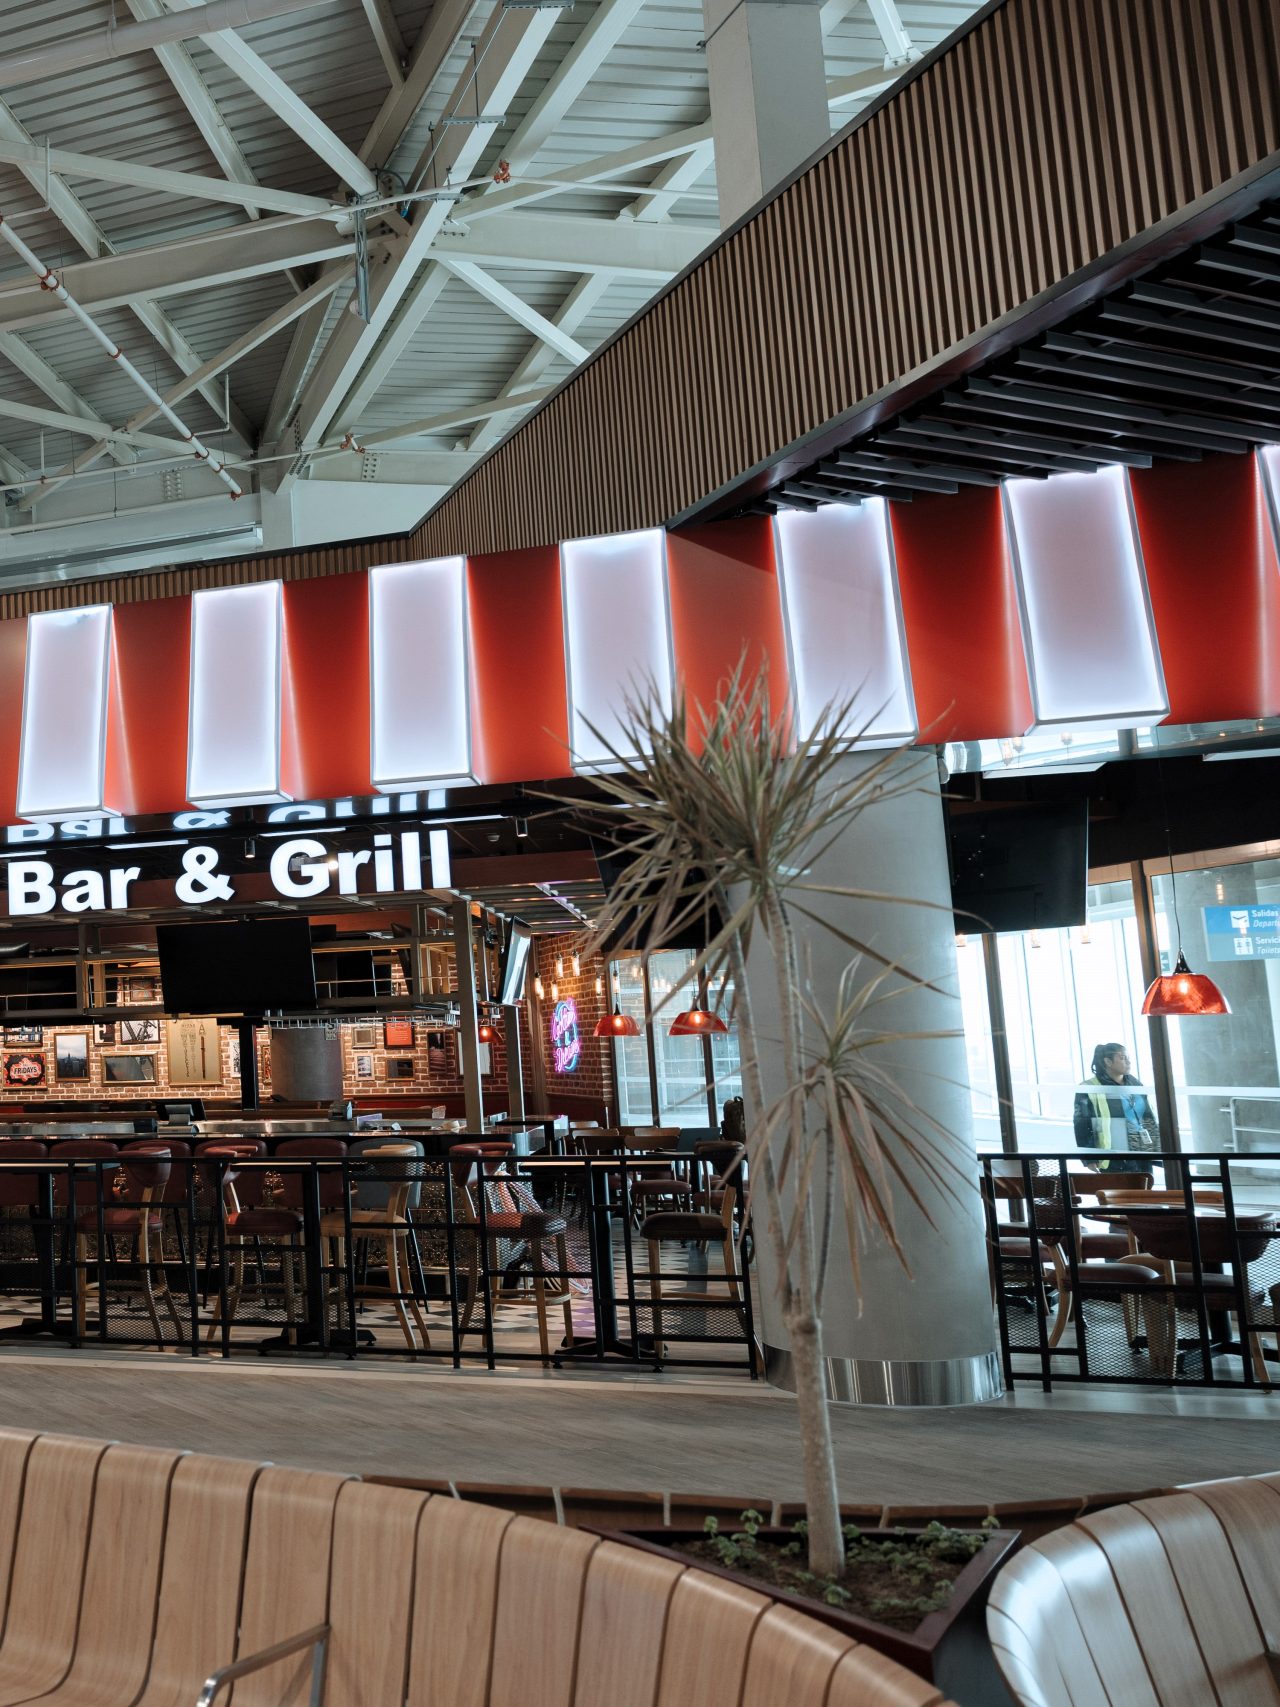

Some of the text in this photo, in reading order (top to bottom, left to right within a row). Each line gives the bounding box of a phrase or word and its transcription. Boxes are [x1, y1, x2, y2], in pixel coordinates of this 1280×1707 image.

[7, 860, 141, 916] Bar
[174, 846, 235, 904] &
[270, 829, 452, 899] Grill
[1253, 919, 1280, 928] Depart
